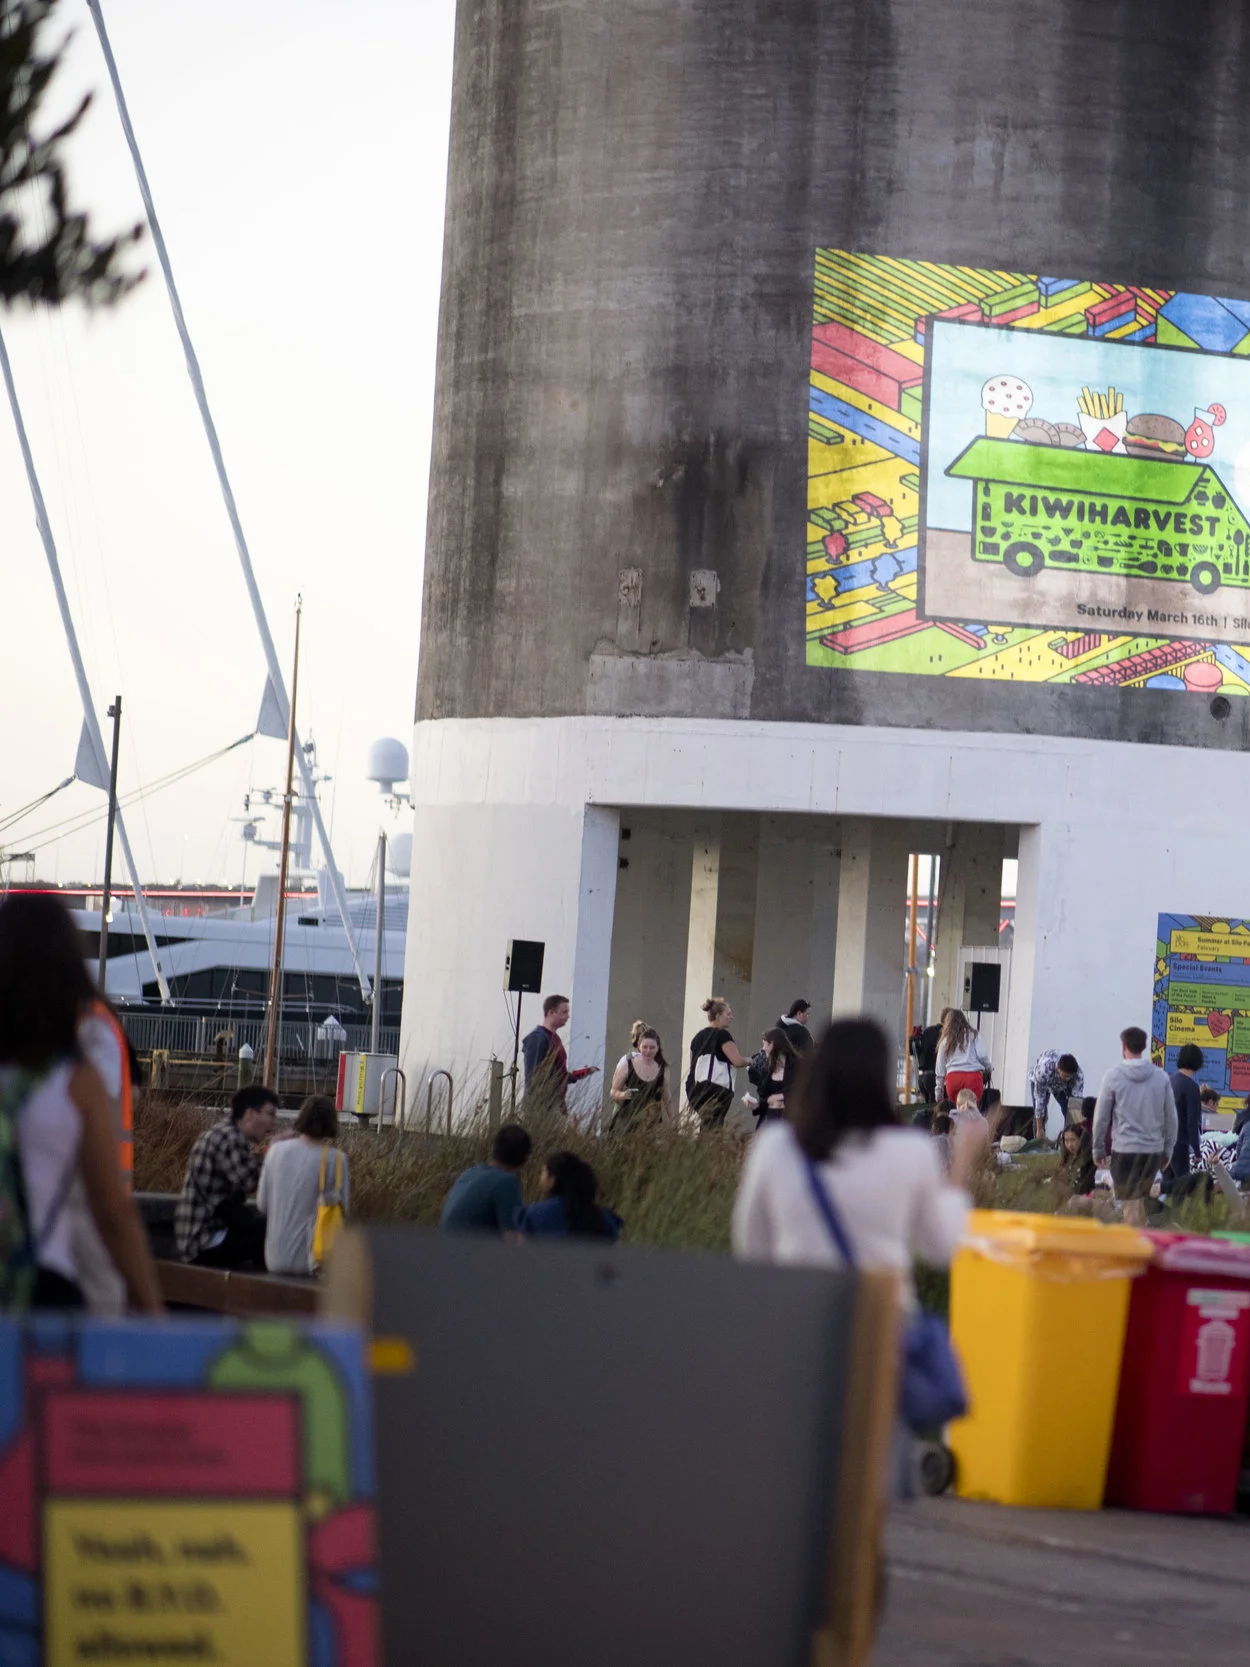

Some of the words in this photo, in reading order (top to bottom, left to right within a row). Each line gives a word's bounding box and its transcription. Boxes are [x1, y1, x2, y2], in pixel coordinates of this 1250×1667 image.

[1003, 491, 1221, 537] KIWIHARVEST
[1076, 603, 1144, 623] Saturday
[1147, 609, 1188, 625] March
[1191, 611, 1218, 627] 16th
[1197, 936, 1223, 945] Summer
[1172, 963, 1199, 972] Special
[1200, 965, 1222, 973] Events
[1169, 1016, 1183, 1024] Silo
[1169, 1025, 1196, 1033] Cinema
